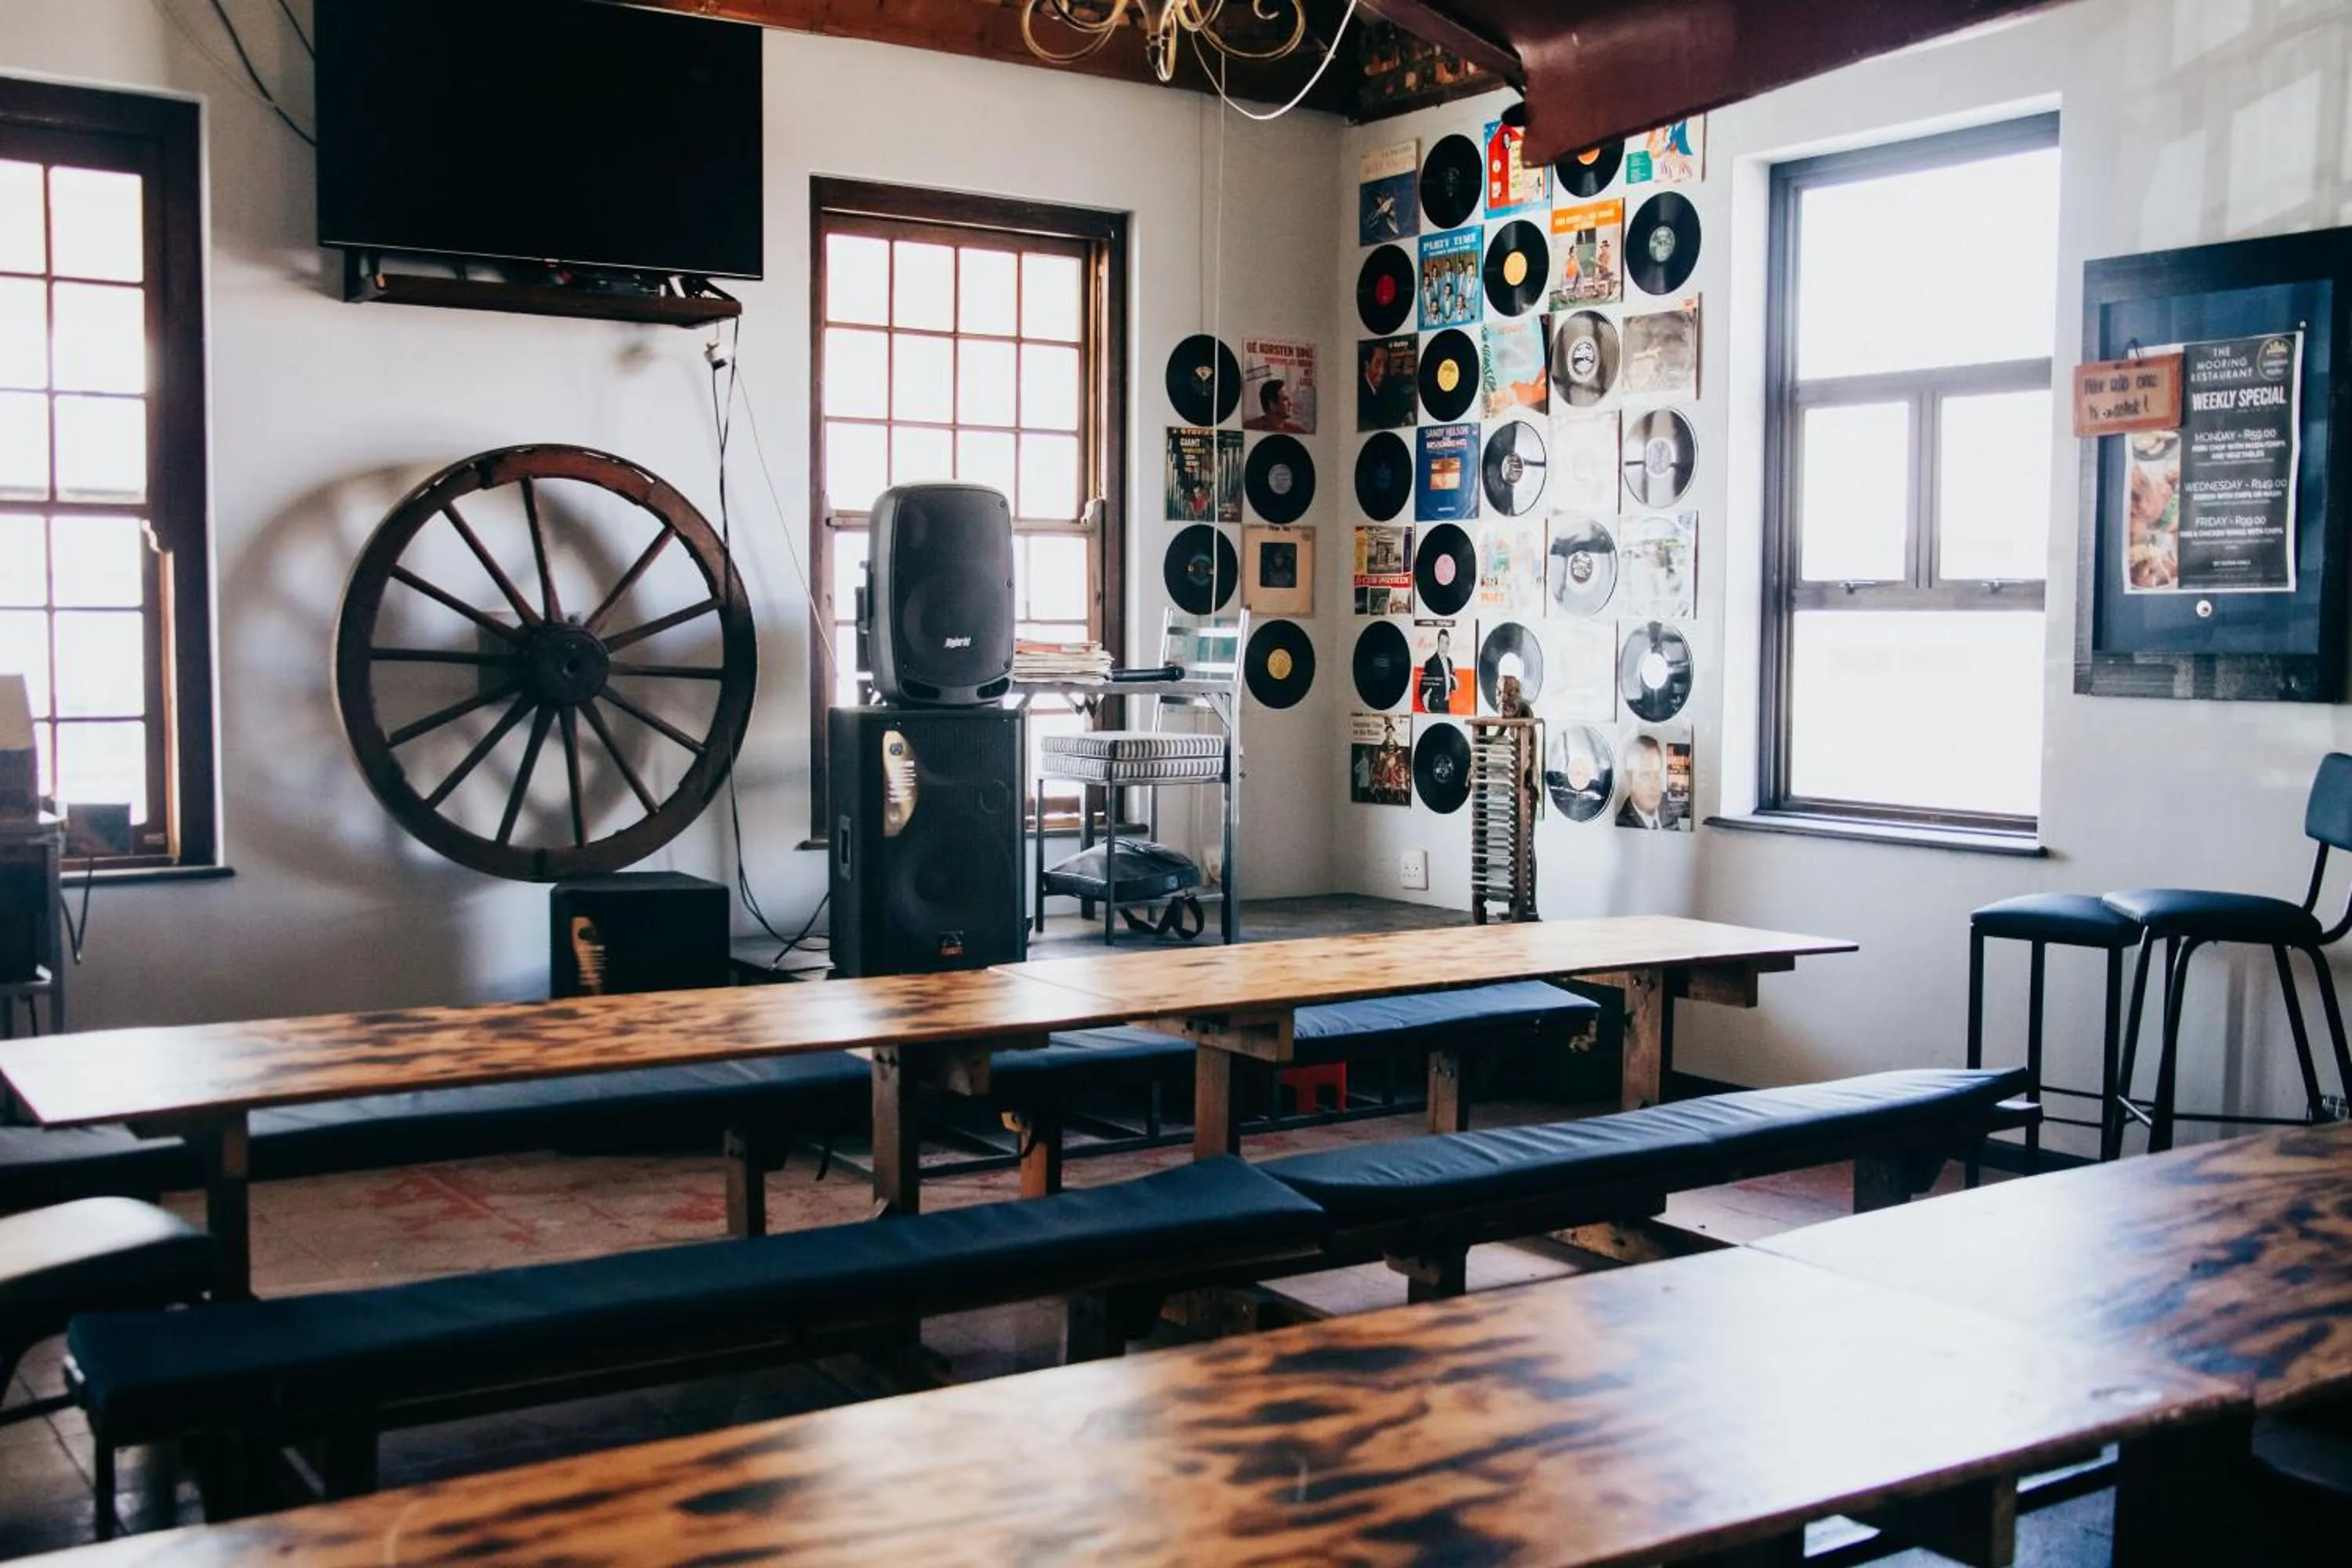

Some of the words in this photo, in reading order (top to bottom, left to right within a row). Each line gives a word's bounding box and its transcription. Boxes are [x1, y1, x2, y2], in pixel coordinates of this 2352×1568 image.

[1423, 238, 1449, 252] PARTY
[1454, 233, 1476, 245] TIME
[2212, 346, 2231, 357] THE
[2190, 368, 2253, 383] RESTAURANT
[2192, 390, 2237, 412] WEEKLY
[2238, 385, 2287, 408] SPECIAL
[2194, 430, 2236, 443] MONDAY
[2183, 479, 2244, 492] WEDNESDAY
[2195, 516, 2227, 528] FRIDAY
